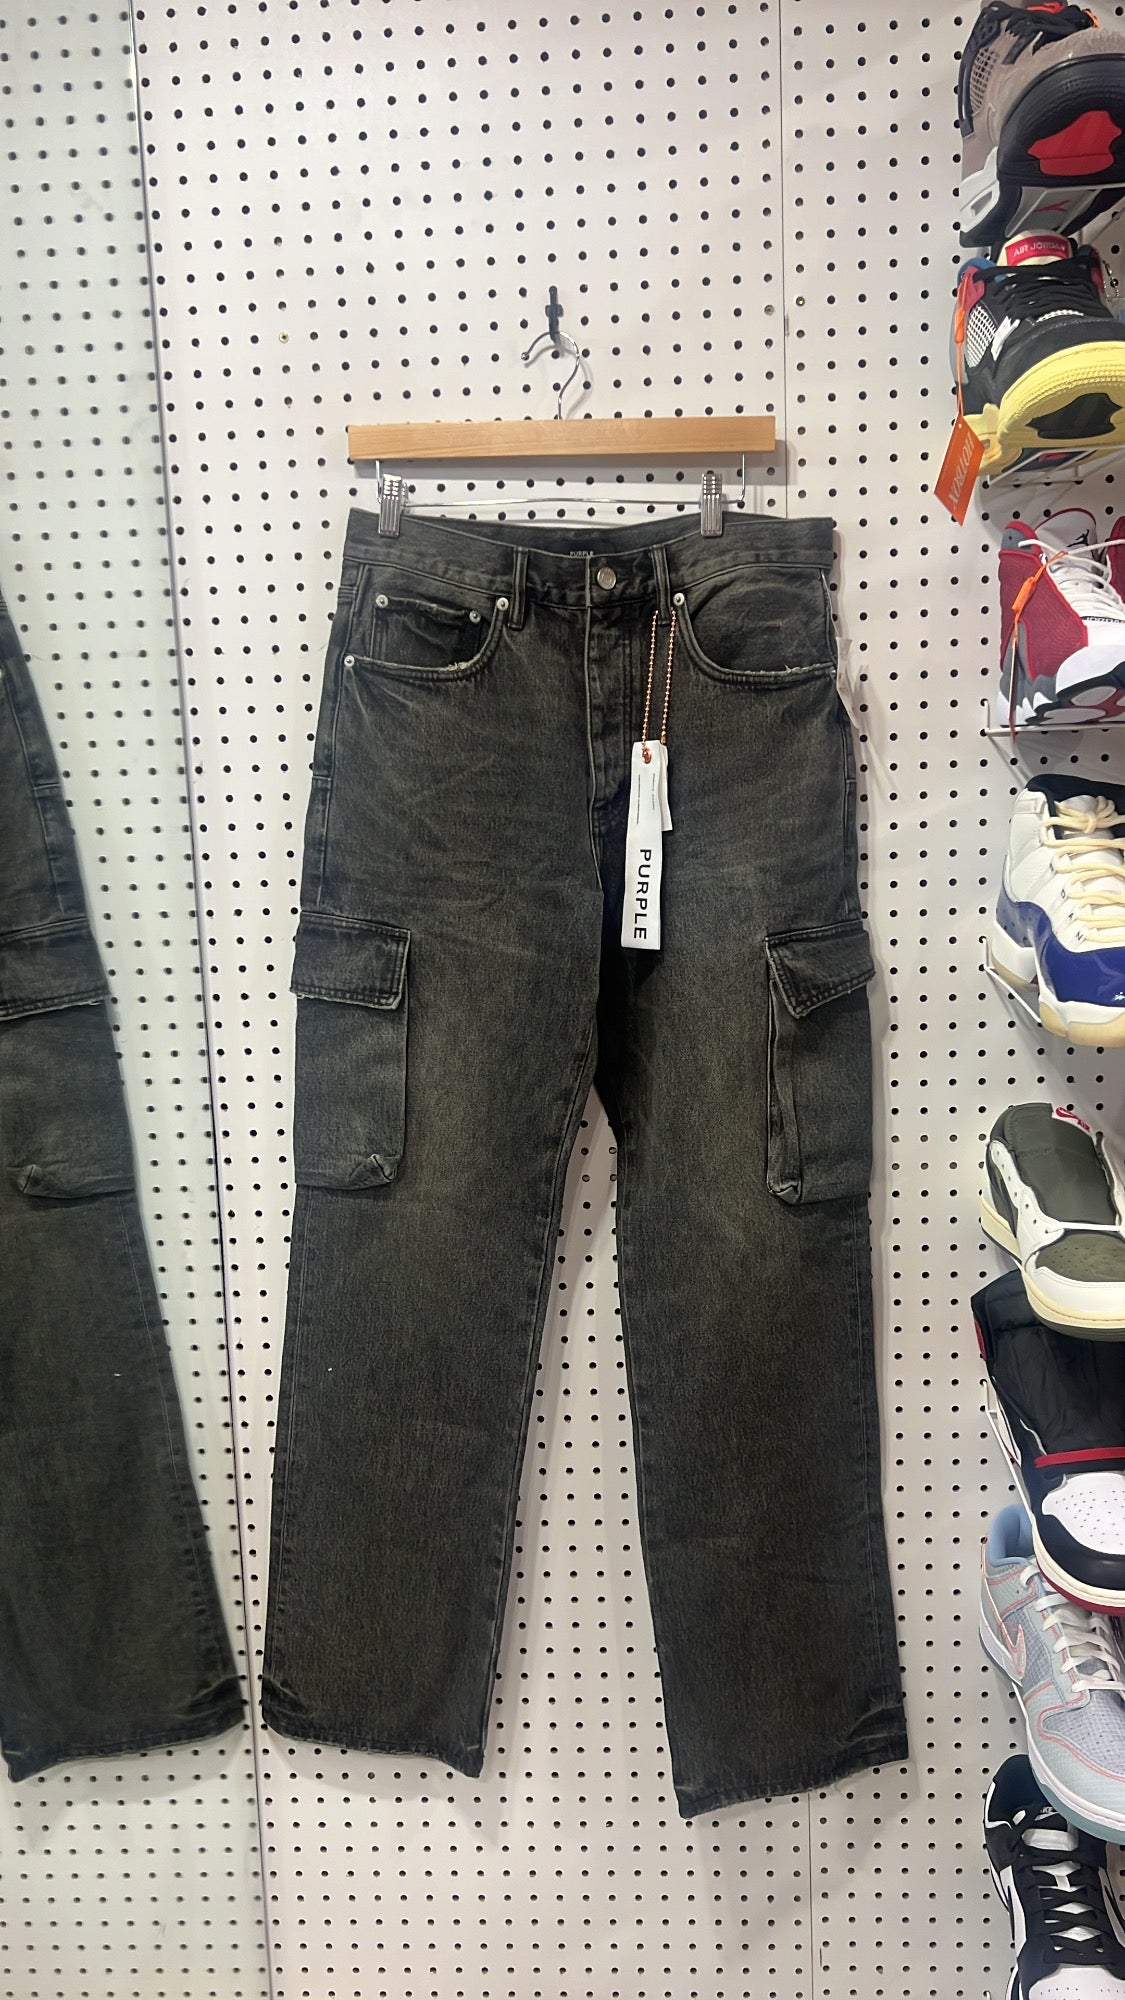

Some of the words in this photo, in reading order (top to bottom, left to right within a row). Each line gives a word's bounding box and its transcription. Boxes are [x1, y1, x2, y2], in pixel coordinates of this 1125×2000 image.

[1014, 245, 1028, 256] AIR
[1031, 242, 1066, 252] JORDAN
[634, 849, 652, 939] PURPLE
